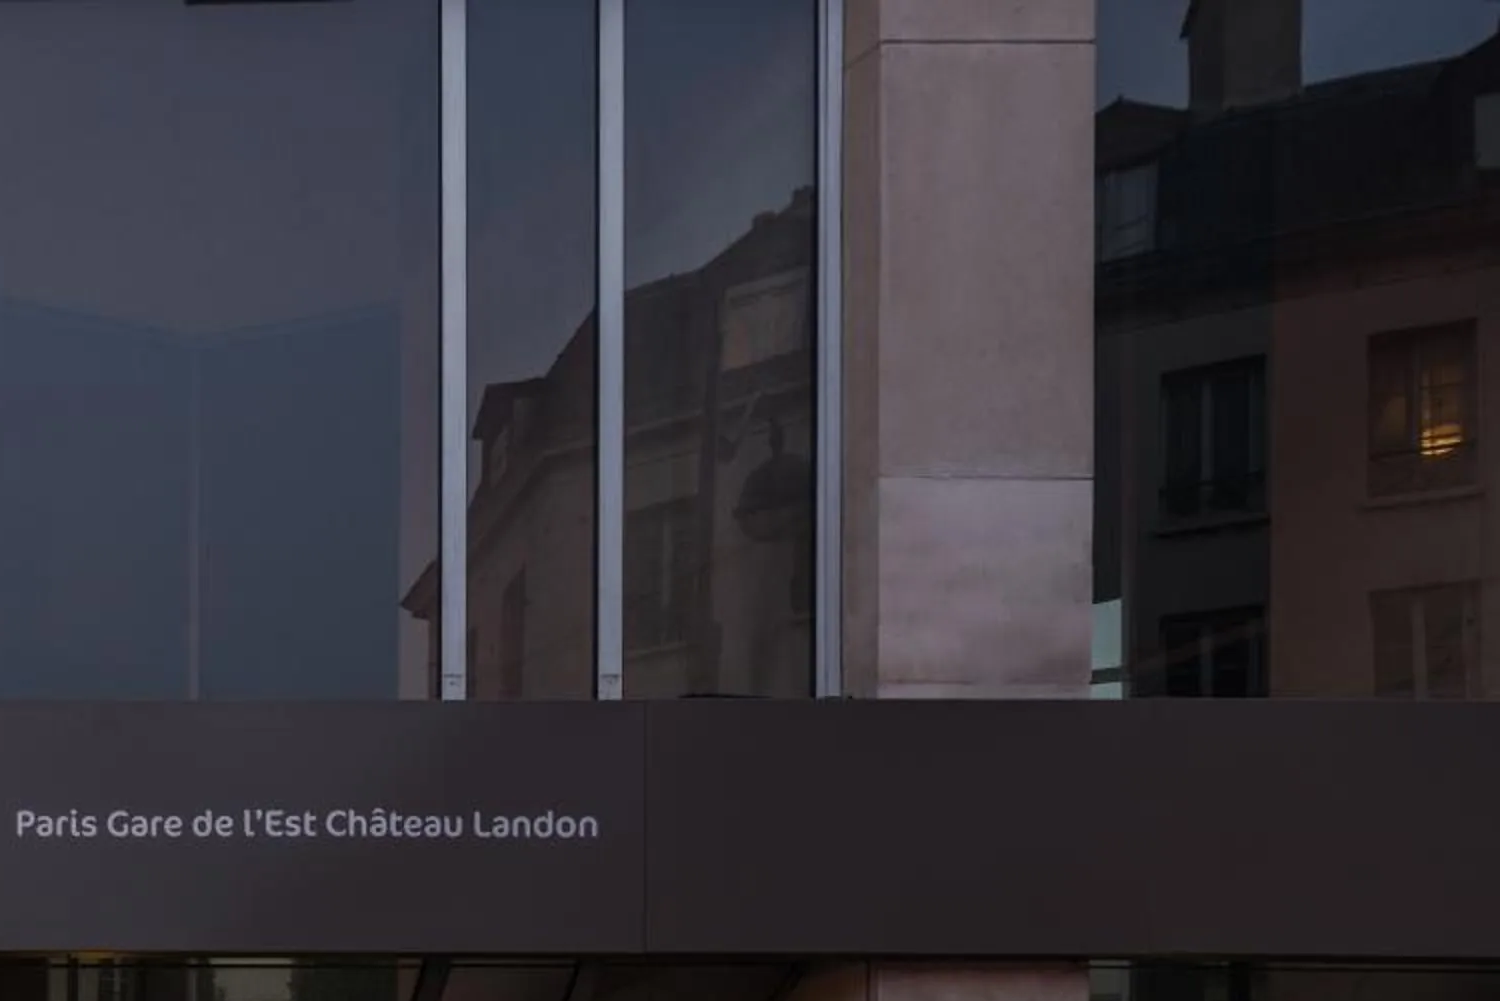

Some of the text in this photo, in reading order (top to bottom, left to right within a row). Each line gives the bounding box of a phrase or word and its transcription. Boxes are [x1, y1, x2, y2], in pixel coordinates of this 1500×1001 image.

[15, 807, 598, 839] Paris Gare de l'Est Château Landon
